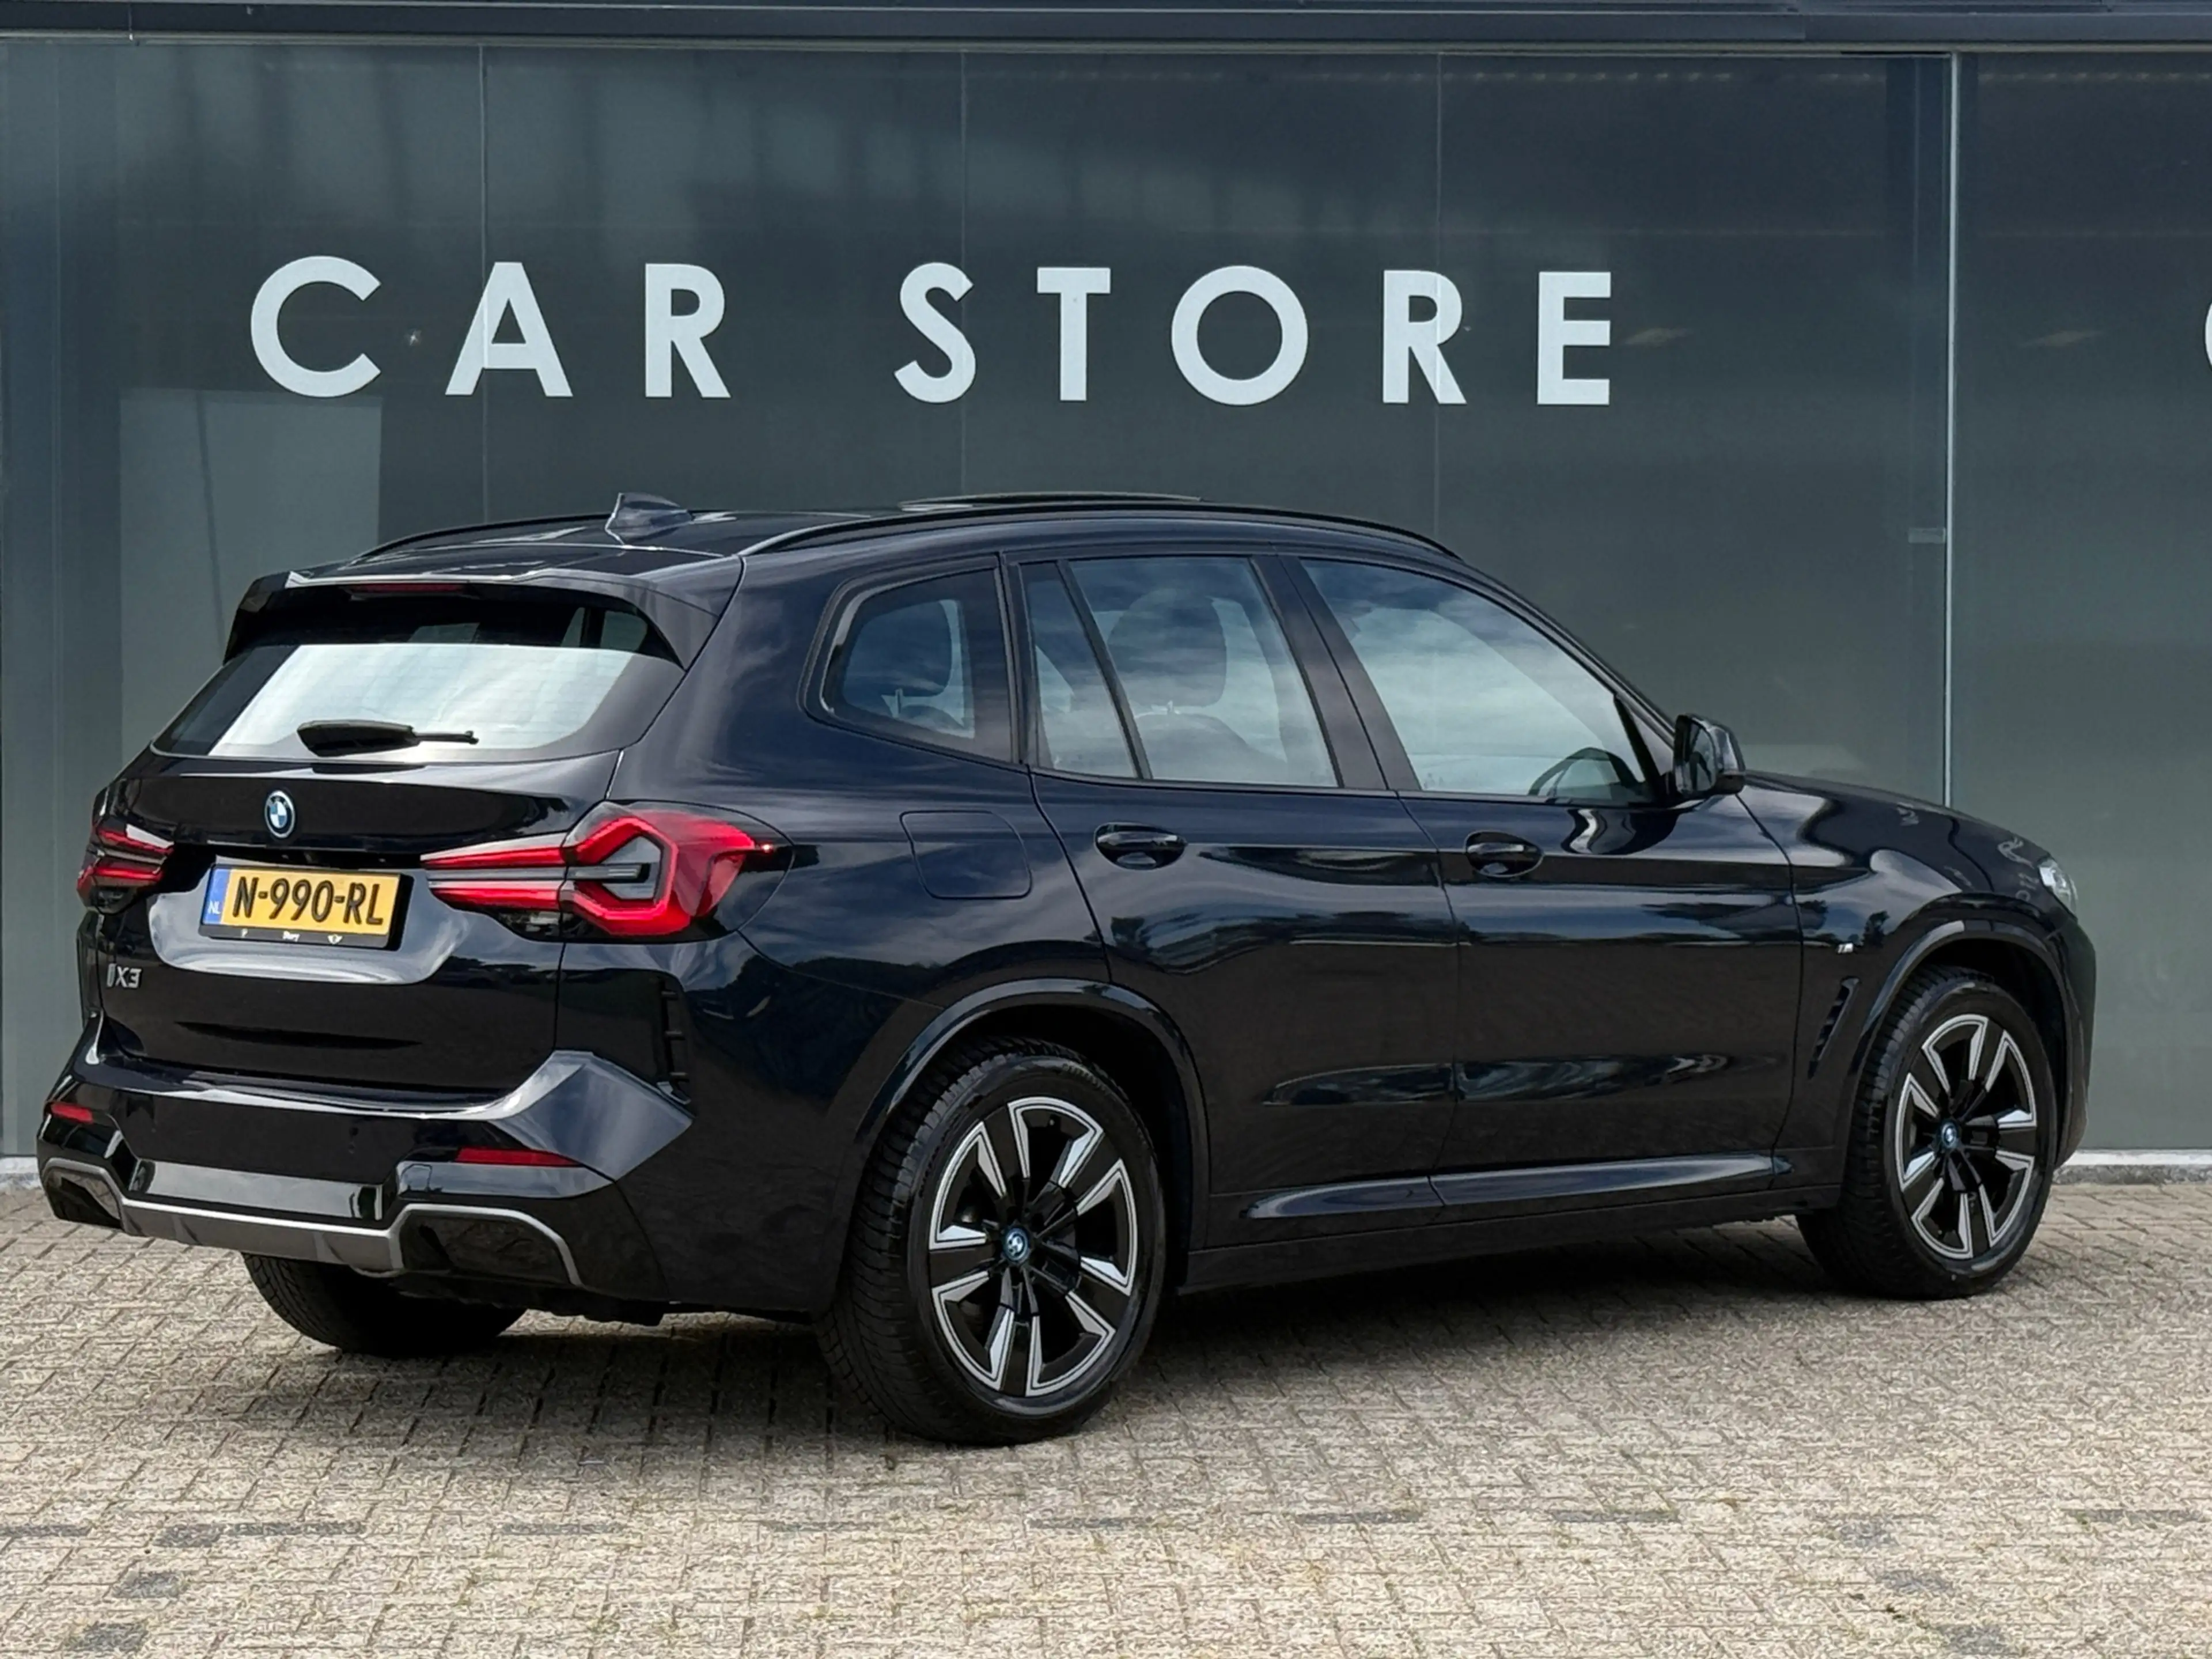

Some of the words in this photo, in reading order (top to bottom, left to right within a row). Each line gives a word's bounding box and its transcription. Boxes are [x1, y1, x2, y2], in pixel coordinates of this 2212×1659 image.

[251, 256, 731, 398] CAR
[894, 262, 1612, 406] STORE
[207, 900, 221, 915] NL
[232, 876, 384, 925] N-990-RL
